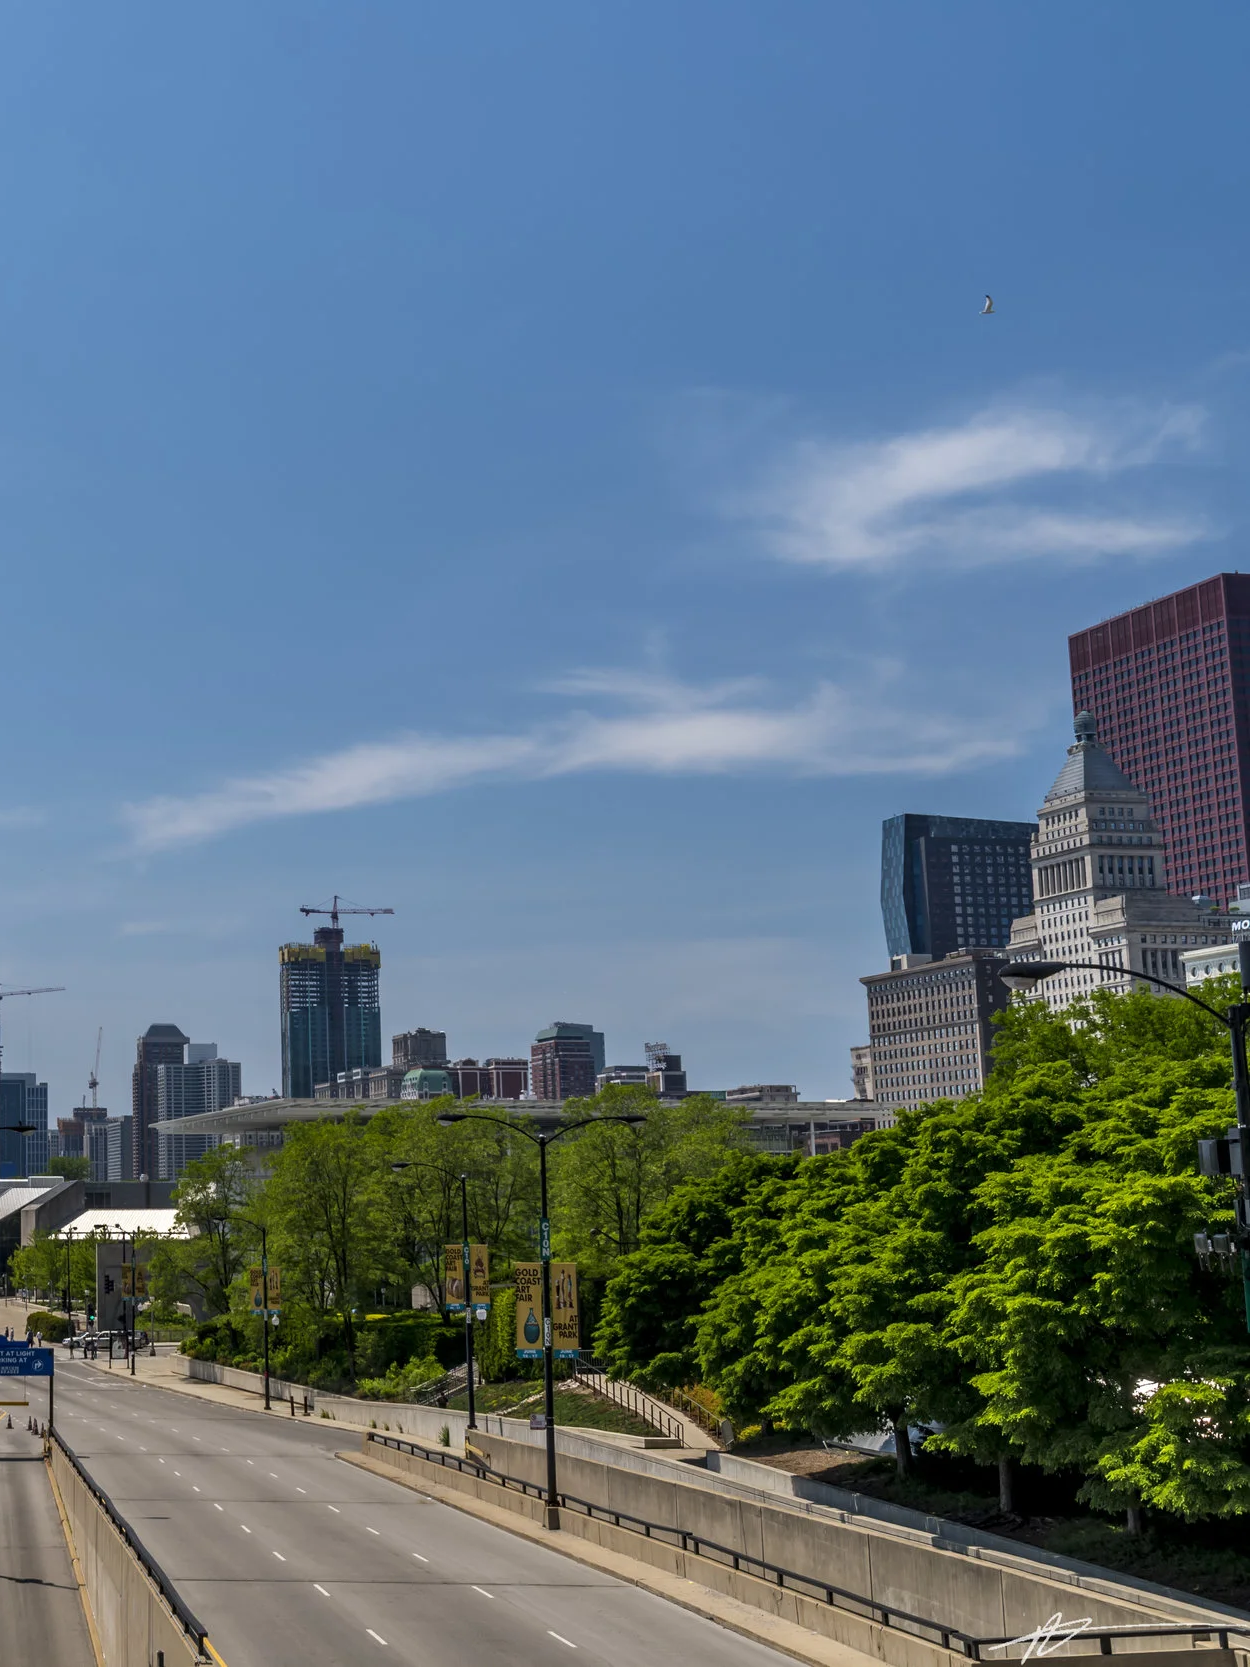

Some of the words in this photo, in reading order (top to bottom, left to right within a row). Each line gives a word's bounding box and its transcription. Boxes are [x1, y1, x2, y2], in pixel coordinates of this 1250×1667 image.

[541, 1222, 550, 1256] C10N
[515, 1277, 541, 1285] COAST
[515, 1294, 532, 1302] FAIR
[553, 1323, 578, 1331] GRANT
[559, 1331, 577, 1339] PARK
